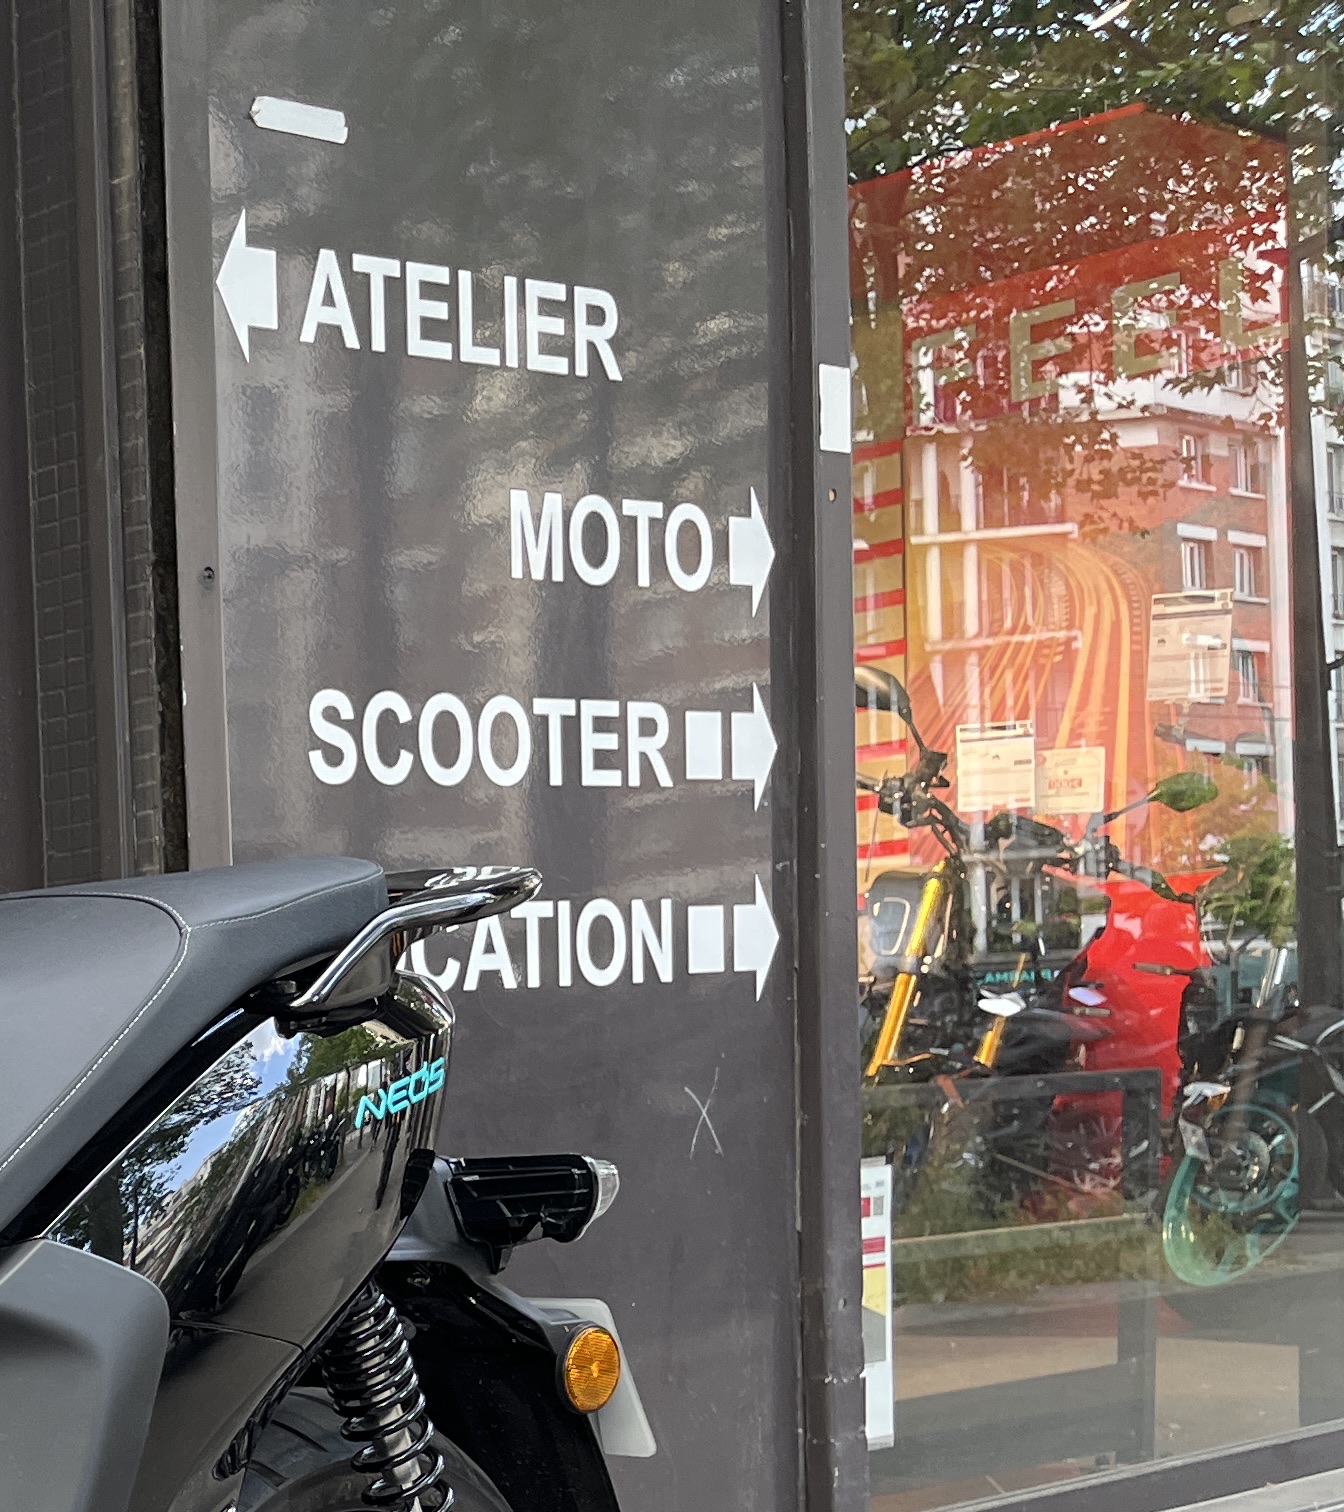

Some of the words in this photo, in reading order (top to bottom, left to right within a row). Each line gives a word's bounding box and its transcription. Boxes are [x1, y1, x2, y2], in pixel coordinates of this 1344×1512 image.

[300, 249, 623, 383] ATELIER
[508, 488, 715, 592] MOTO
[307, 687, 674, 790] SCOOTER
[397, 897, 674, 993] CATION
